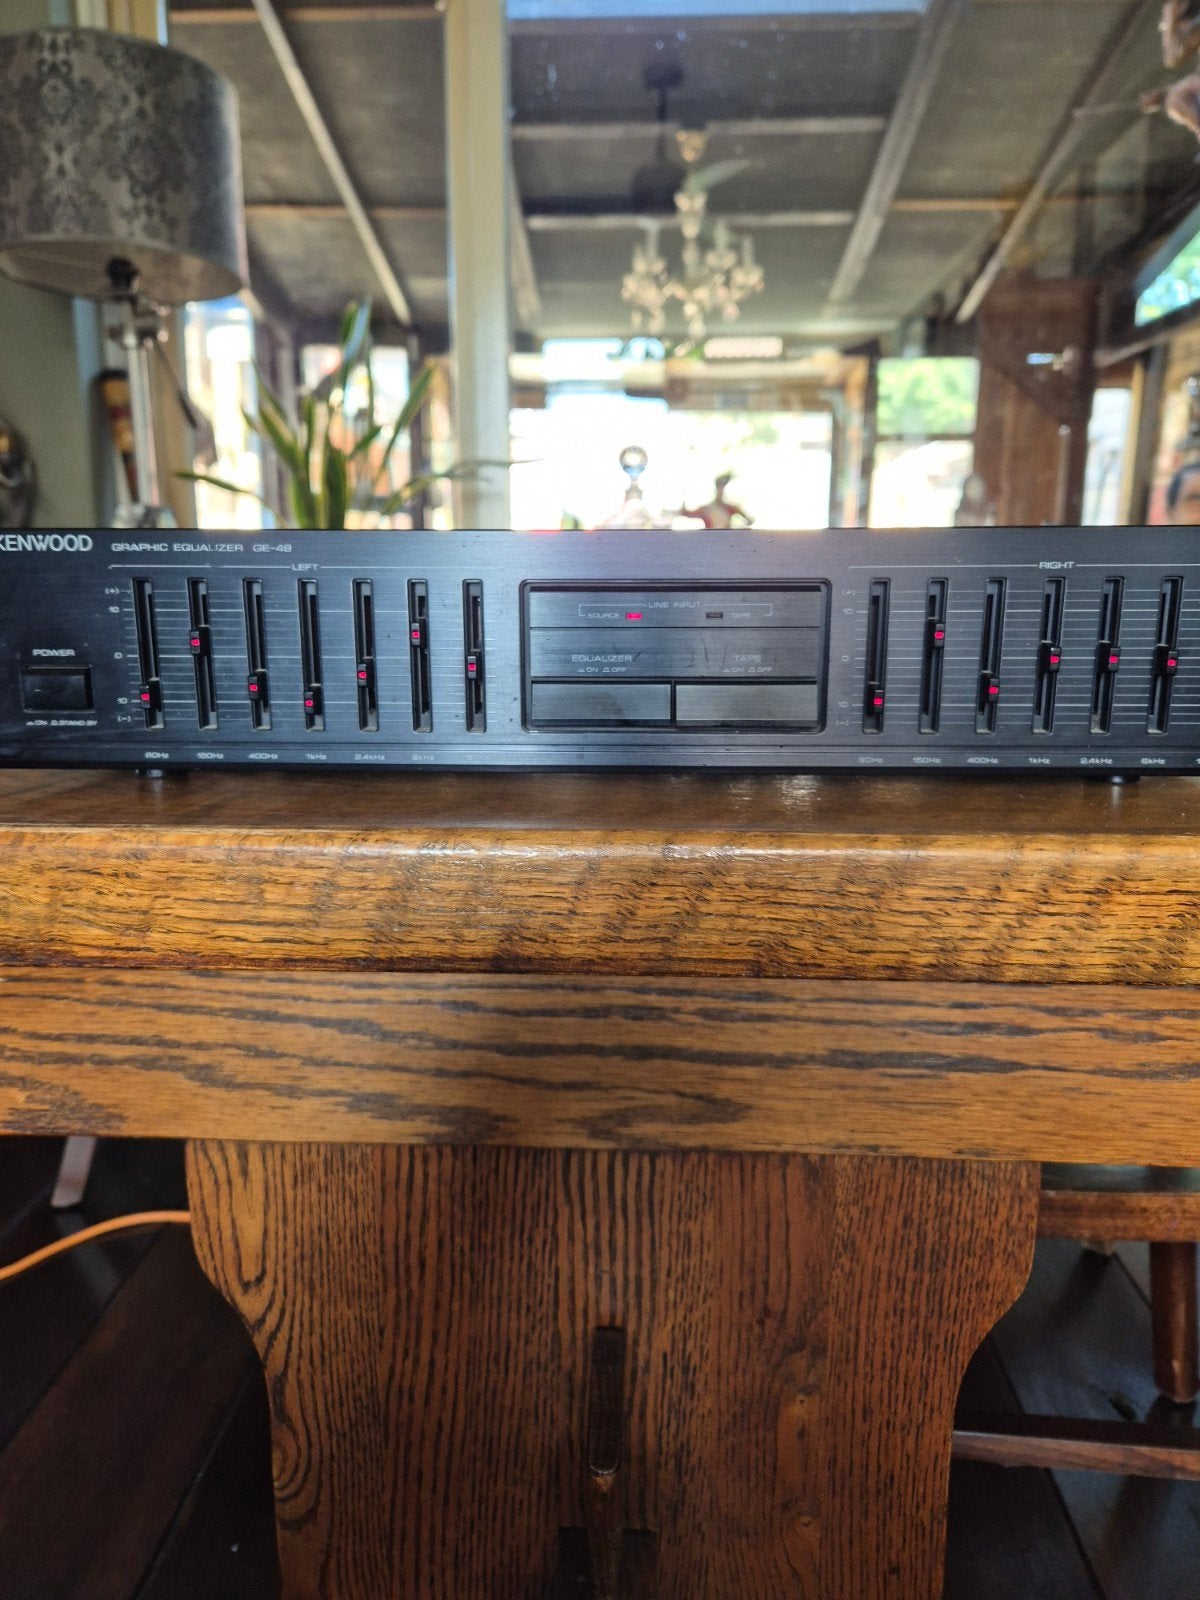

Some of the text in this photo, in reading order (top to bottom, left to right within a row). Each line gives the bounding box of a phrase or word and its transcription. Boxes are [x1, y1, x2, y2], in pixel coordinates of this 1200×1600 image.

[111, 543, 168, 552] GRAPHIC
[173, 543, 244, 552] EQUALIZER
[292, 563, 319, 571] LEFT
[1039, 561, 1075, 569] RIGHT
[32, 649, 76, 657] POWER
[571, 654, 633, 662] EQUALIZER
[734, 654, 763, 663] TAPE
[196, 752, 225, 760] 150Hz
[912, 756, 942, 764] 150Hz
[967, 756, 999, 764] 400Hz
[1080, 757, 1113, 765] 2.4kHz
[1140, 757, 1166, 765] 6kHz
